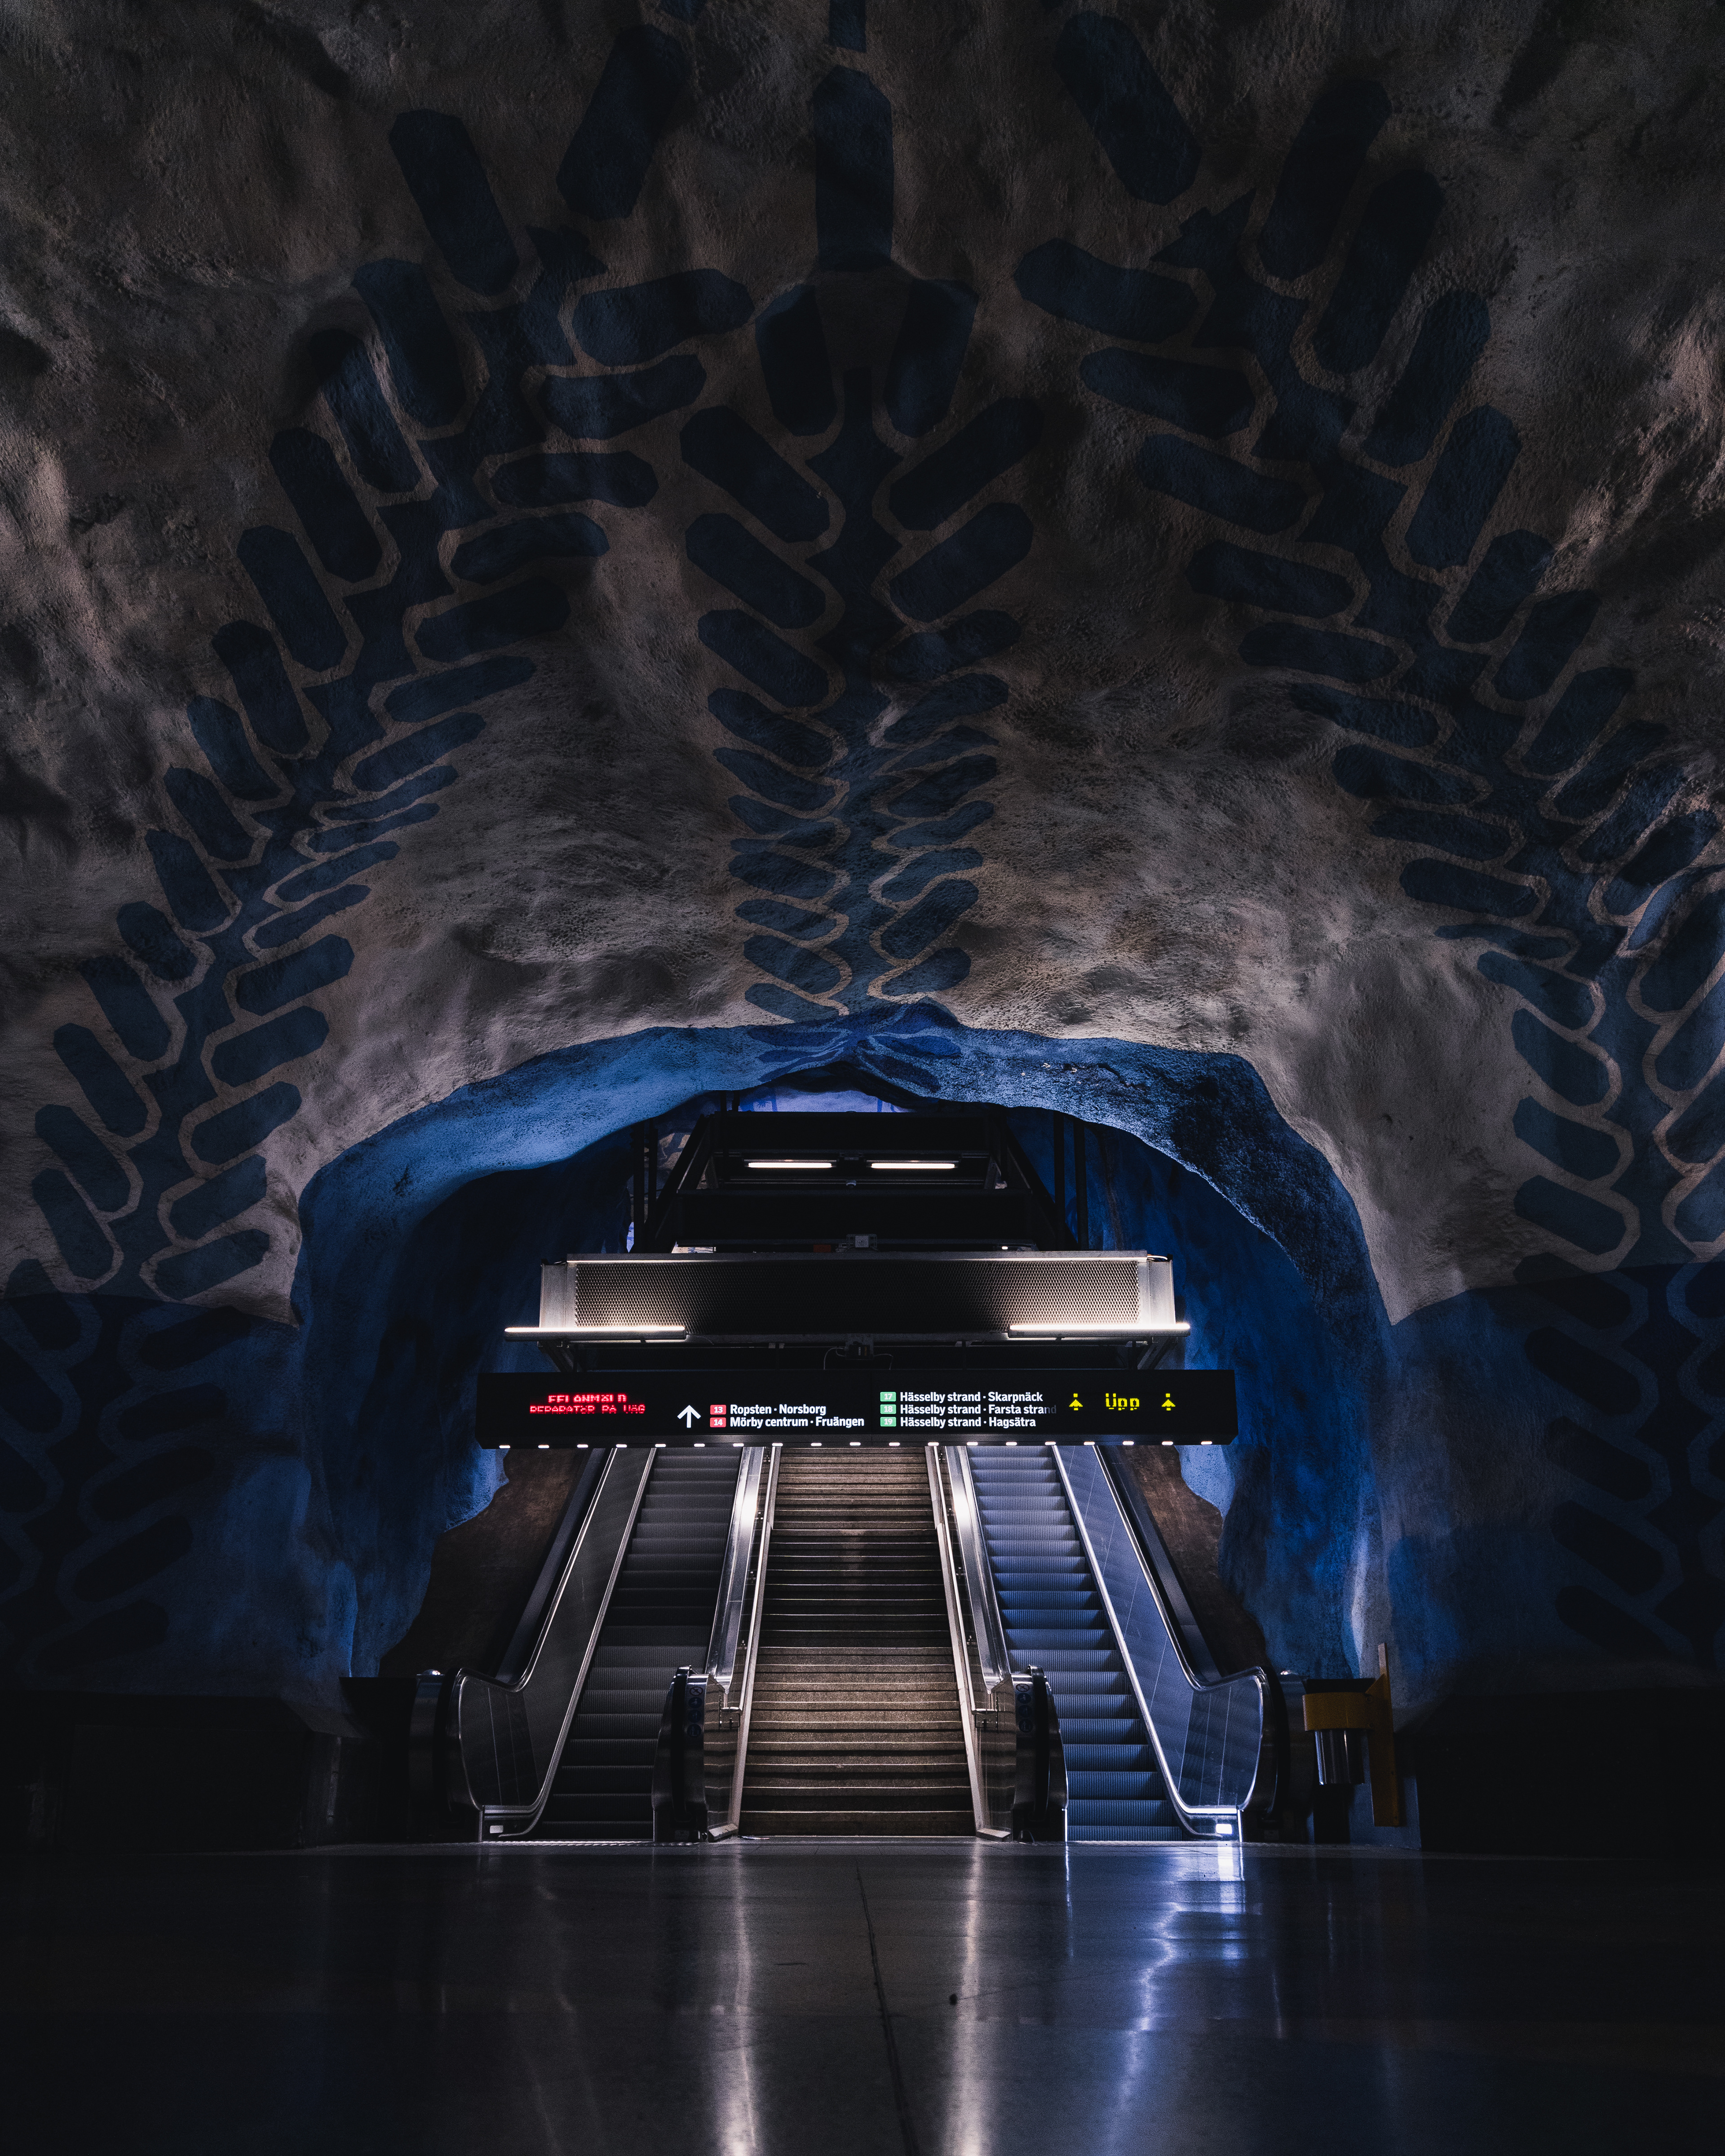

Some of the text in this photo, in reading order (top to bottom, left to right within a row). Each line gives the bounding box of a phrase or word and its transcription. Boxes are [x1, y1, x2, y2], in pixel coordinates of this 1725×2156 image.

[900, 1392, 946, 1403] Hässelby
[947, 1392, 981, 1401] strand
[988, 1392, 1044, 1403] Skarpnäck
[730, 1404, 772, 1416] Ropsten
[779, 1404, 827, 1416] Norsborg
[900, 1404, 946, 1416] Hässelby
[947, 1404, 981, 1414] strand
[989, 1404, 1022, 1414] Farsta
[1023, 1404, 1056, 1414] strand
[730, 1417, 763, 1428] Mörby
[765, 1417, 809, 1427] centrum
[816, 1416, 865, 1428] Fruängen
[900, 1417, 946, 1428] Hässelby
[947, 1417, 982, 1427] strand
[989, 1417, 1036, 1428] Hagsätra
